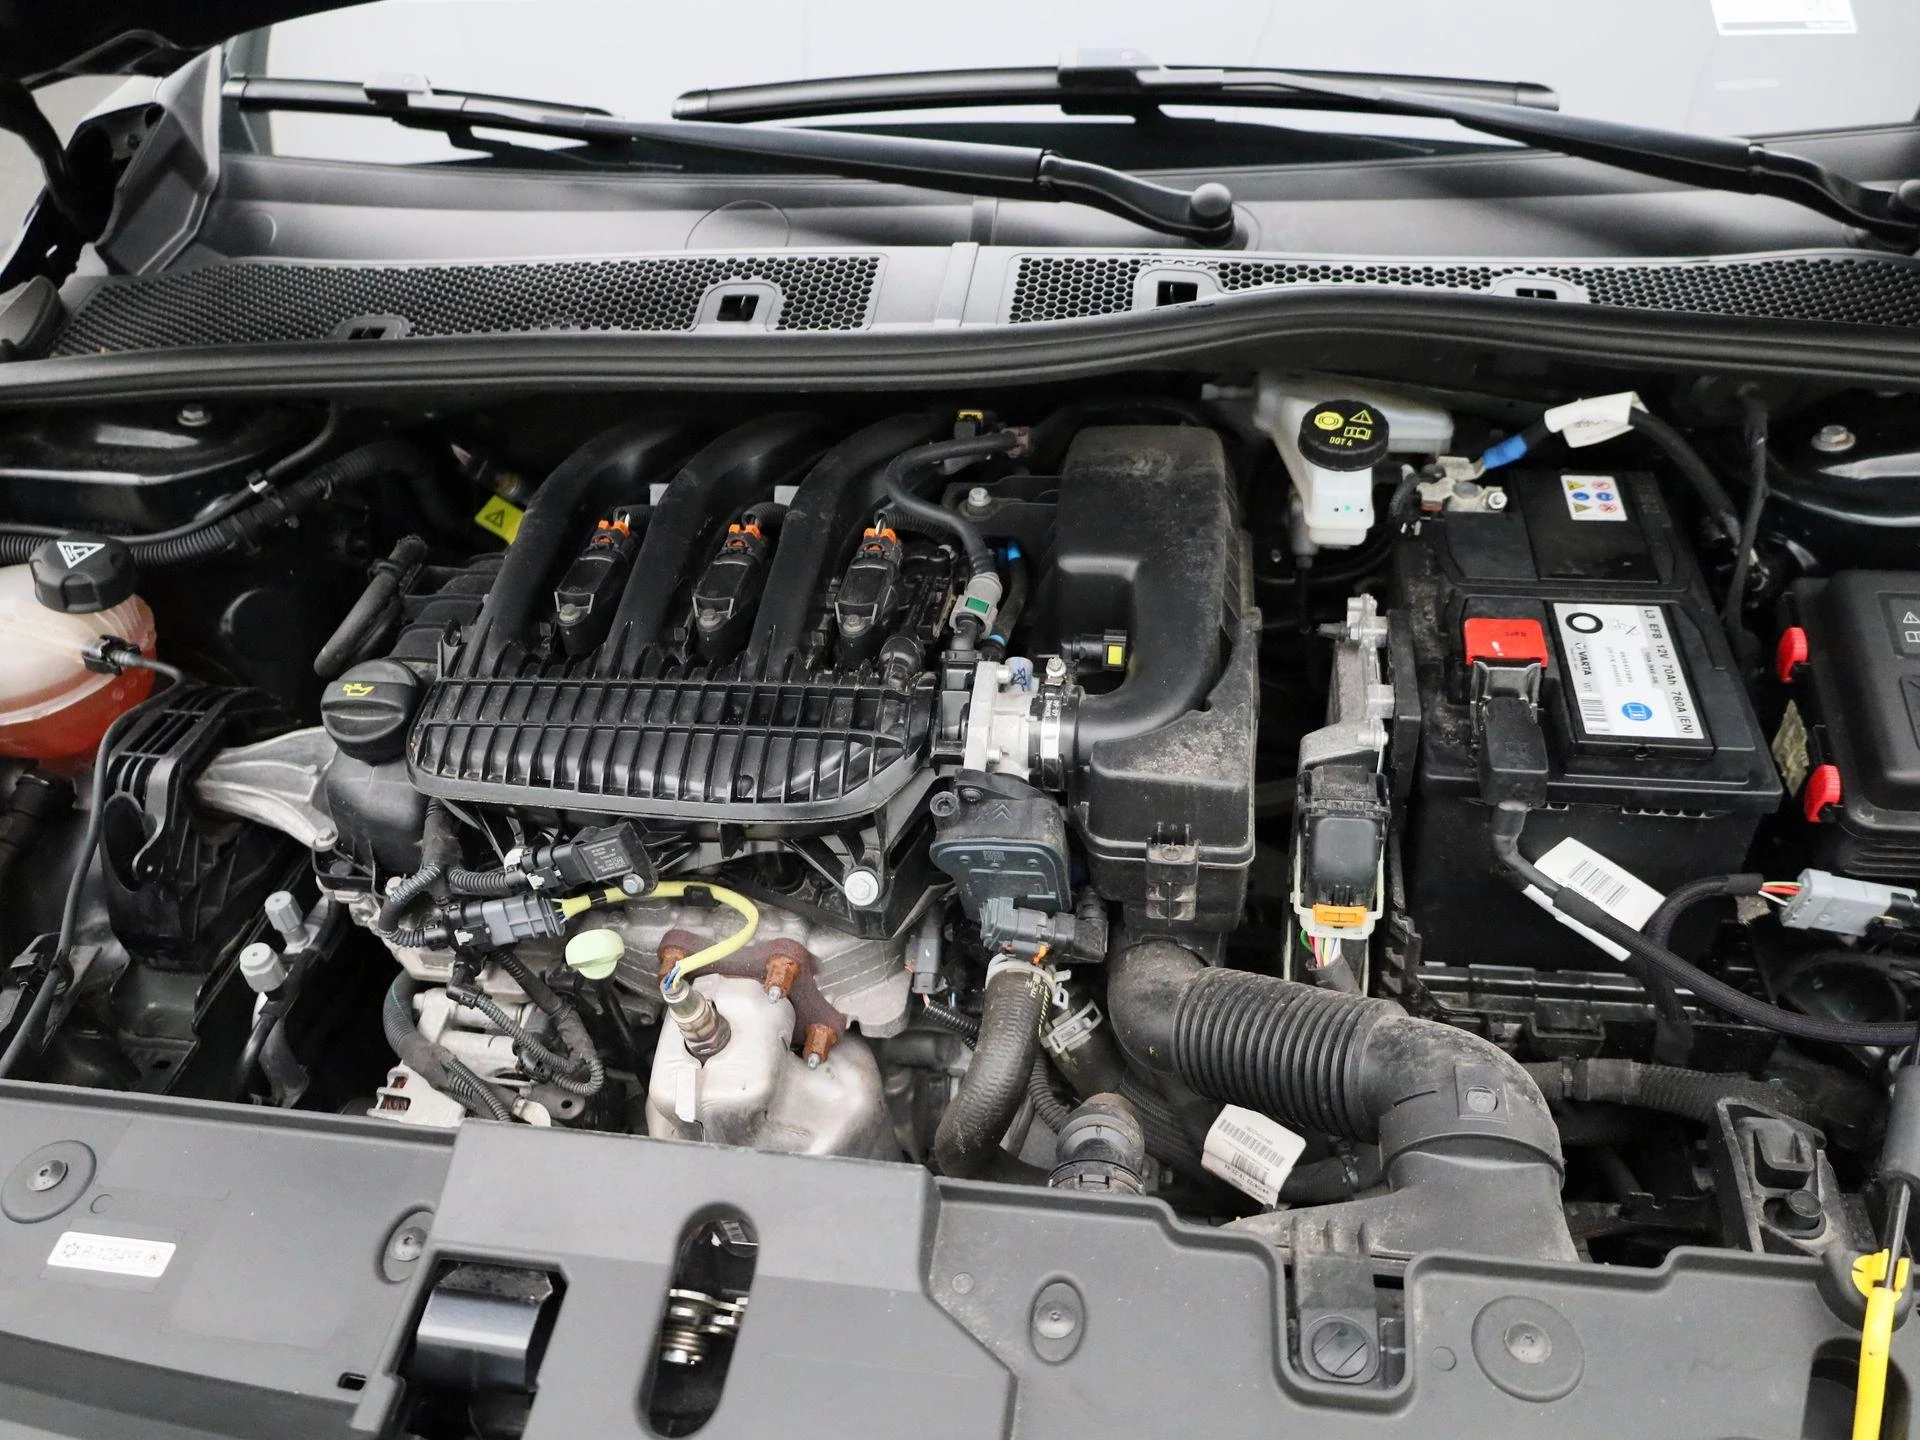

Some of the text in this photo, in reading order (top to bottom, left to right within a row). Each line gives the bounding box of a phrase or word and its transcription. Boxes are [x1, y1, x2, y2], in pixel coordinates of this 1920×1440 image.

[1329, 436, 1346, 445] DOT
[1644, 609, 1655, 619] L3
[1648, 623, 1662, 638] EFB
[1655, 644, 1668, 658] 12V
[1579, 651, 1591, 675] VARTA
[1662, 664, 1677, 684] 70Ah
[1670, 691, 1686, 712] 760A
[1677, 716, 1694, 733] (EN)
